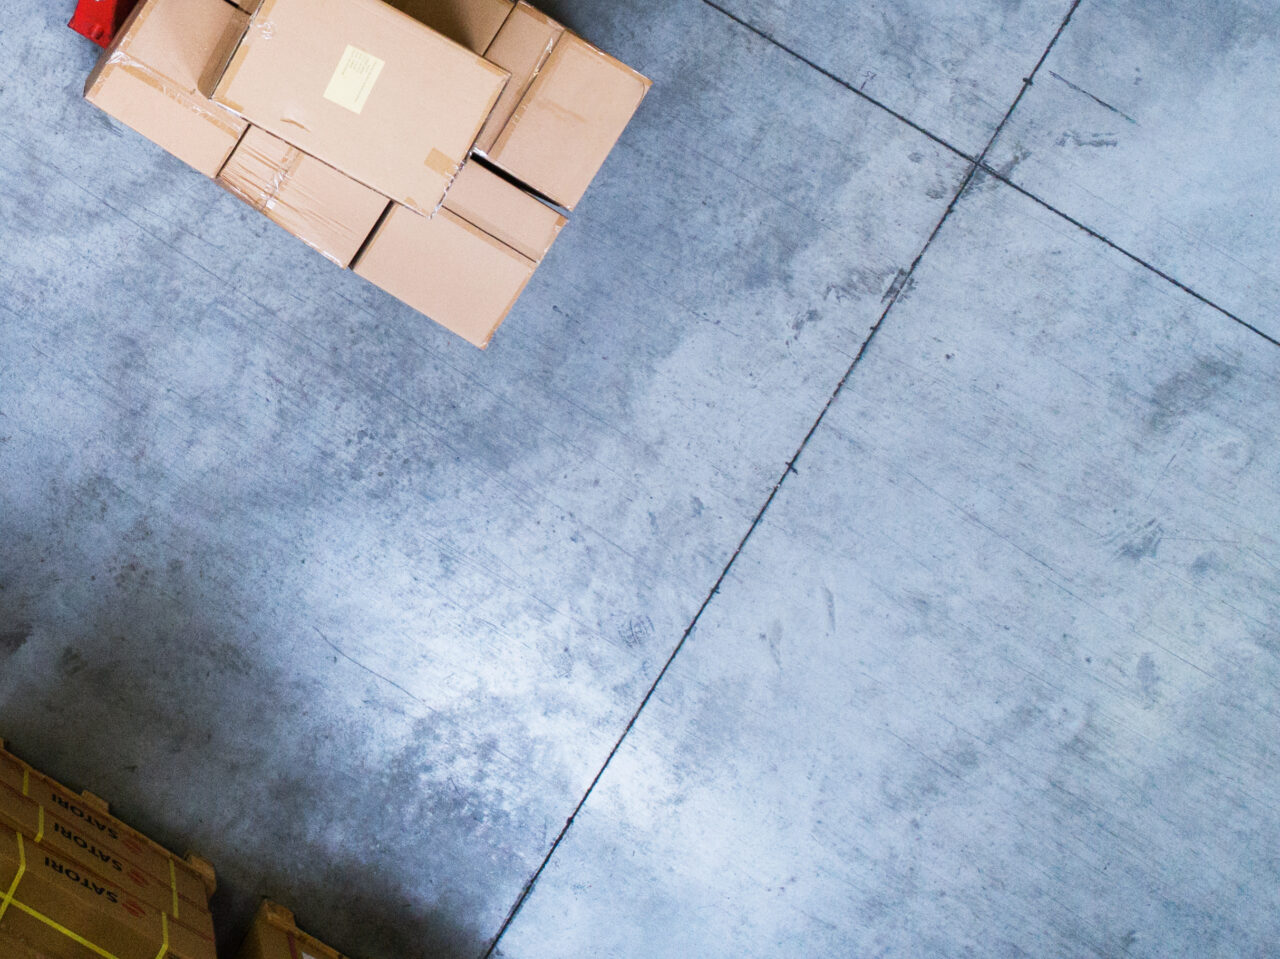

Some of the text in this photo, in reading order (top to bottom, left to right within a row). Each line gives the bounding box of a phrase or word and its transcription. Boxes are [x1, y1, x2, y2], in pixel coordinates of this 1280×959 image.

[51, 794, 118, 840] SATORI
[54, 822, 122, 872] SATORI
[44, 857, 118, 903] SATORI
